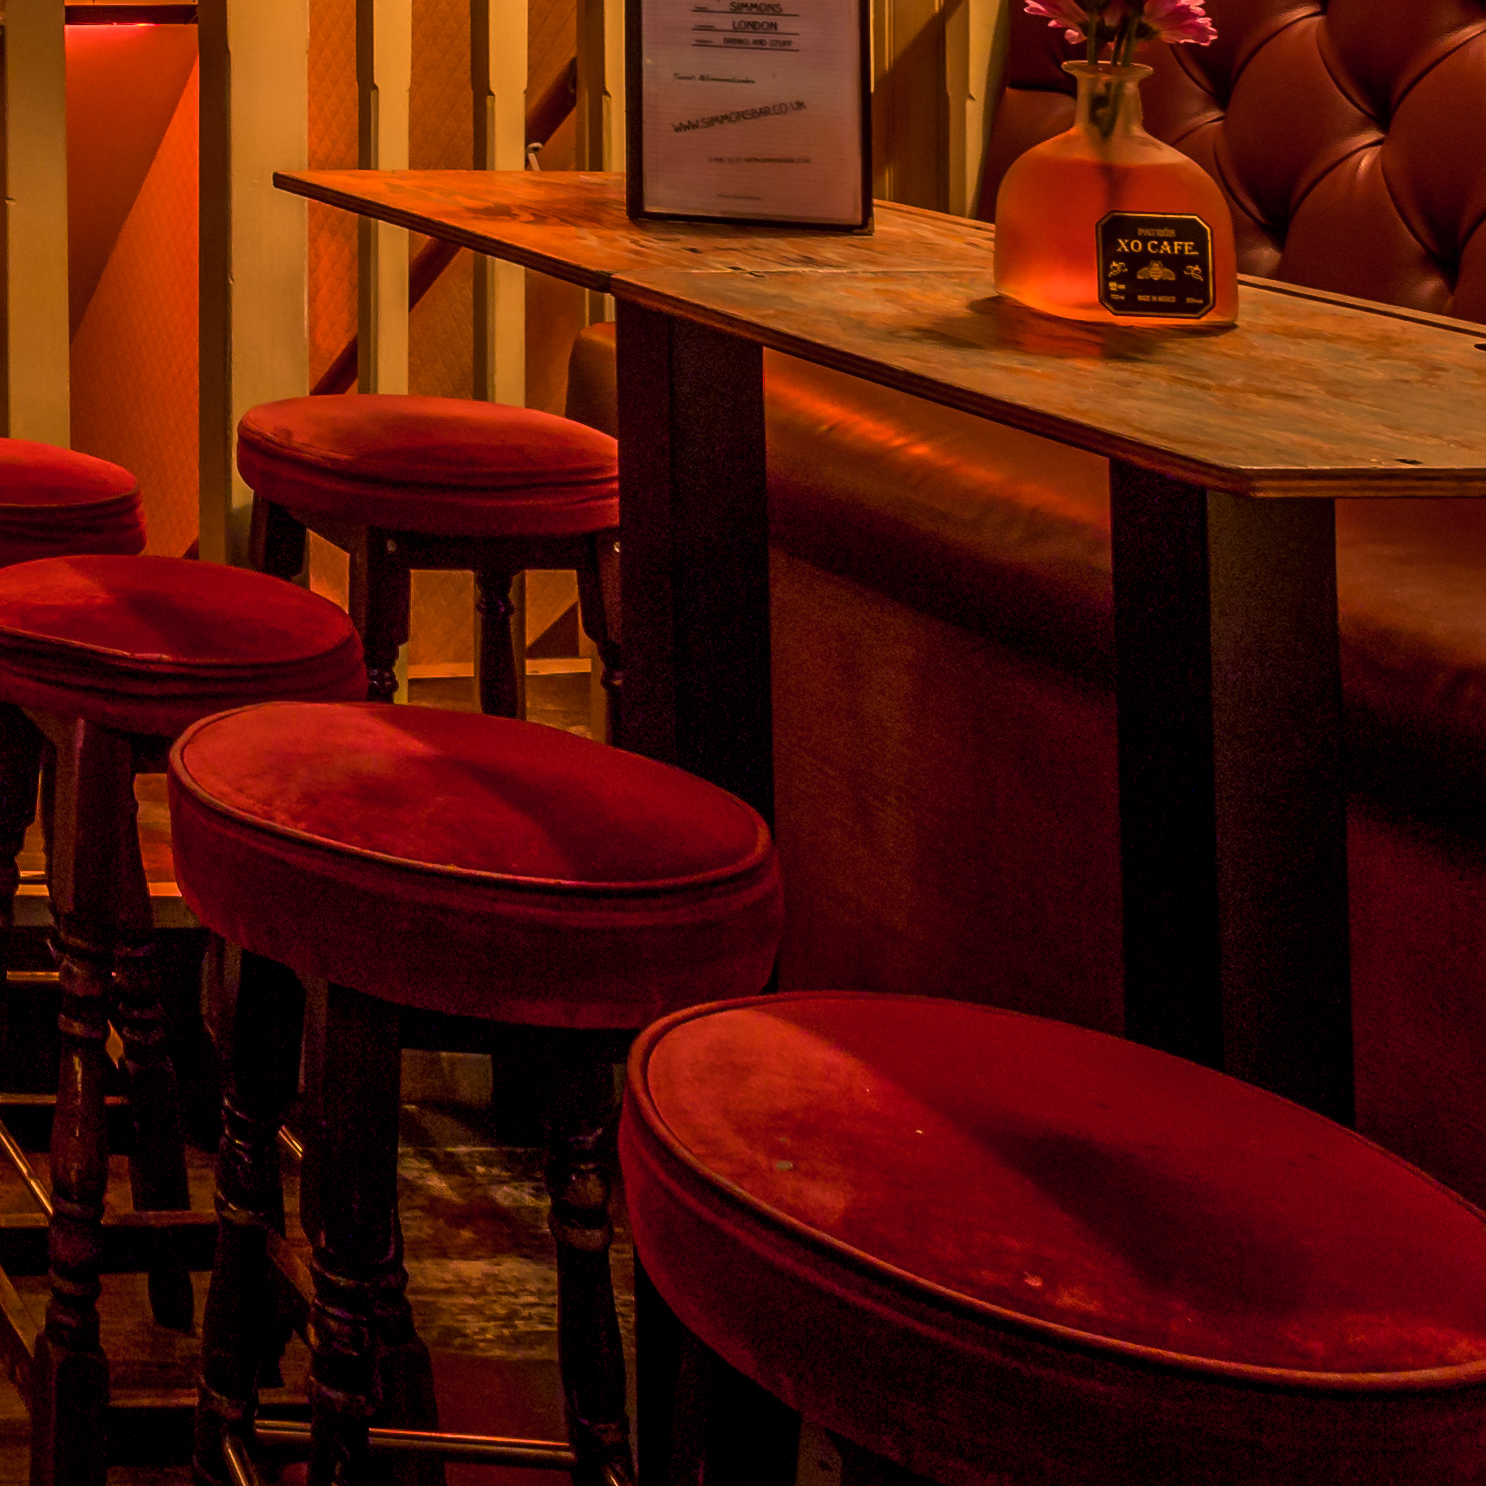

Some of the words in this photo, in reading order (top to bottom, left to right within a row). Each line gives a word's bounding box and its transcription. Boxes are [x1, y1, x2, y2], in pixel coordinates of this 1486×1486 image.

[729, 2, 784, 14] SIMMONS
[731, 20, 778, 31] LONDON
[1116, 238, 1143, 253] XO
